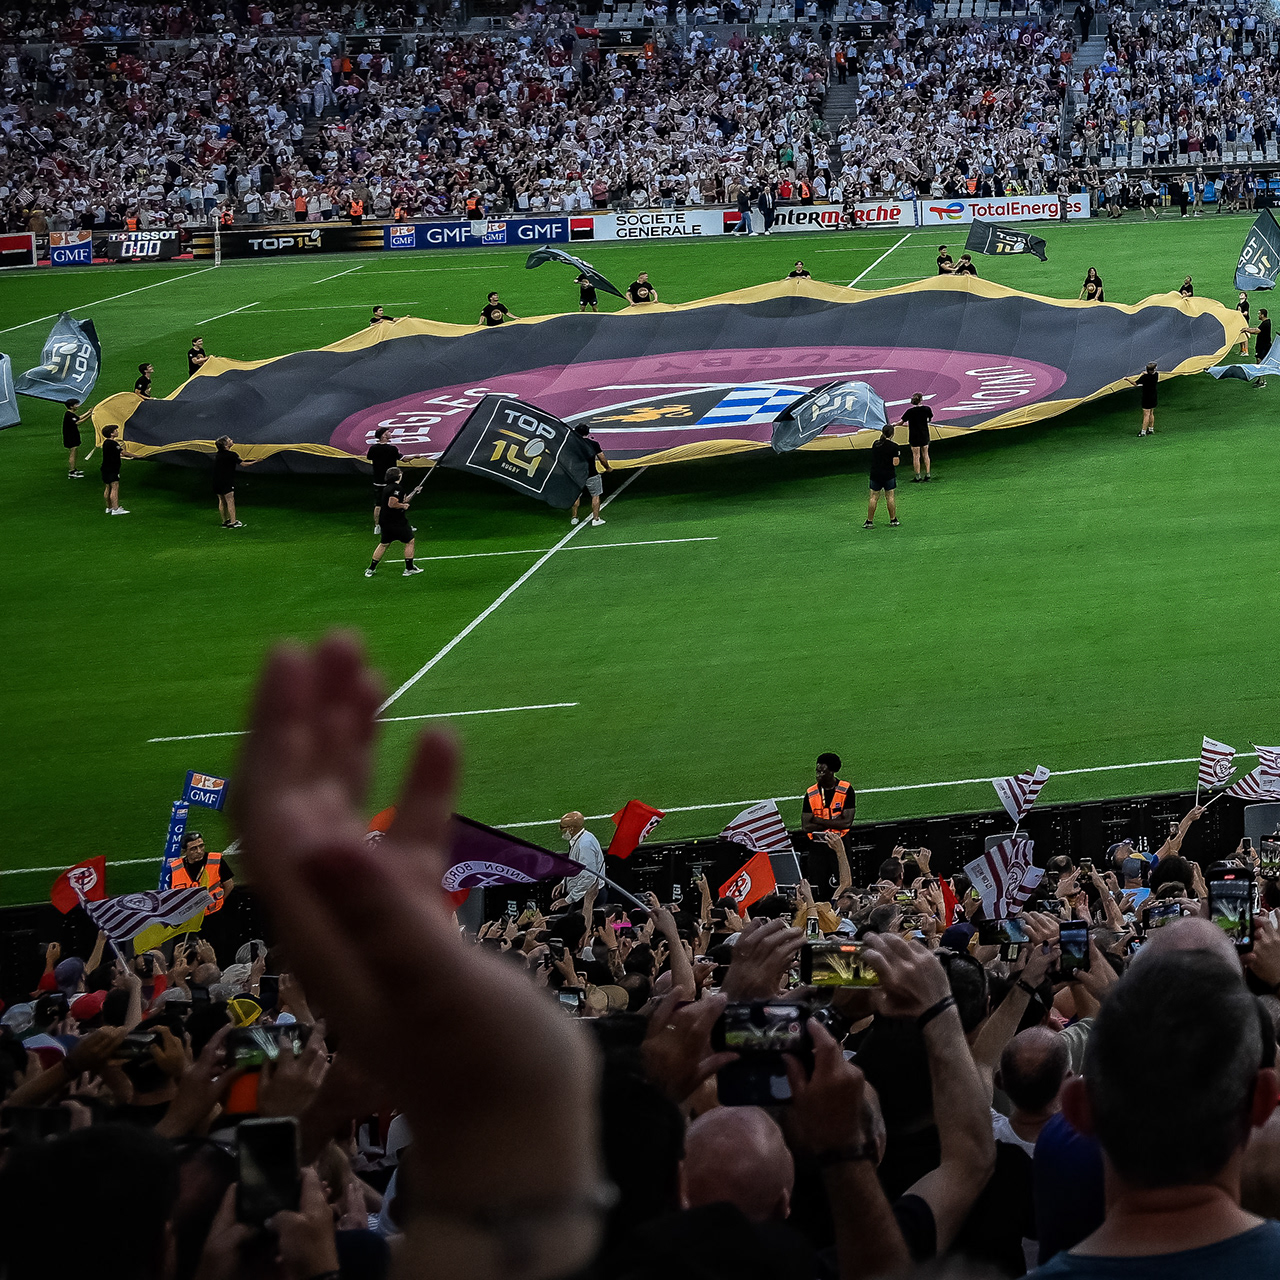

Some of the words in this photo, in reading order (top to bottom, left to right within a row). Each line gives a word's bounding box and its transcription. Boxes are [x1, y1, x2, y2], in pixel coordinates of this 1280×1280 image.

[968, 201, 1081, 218] TotalEnerges
[616, 213, 686, 226] SOCIETE
[128, 230, 178, 241] TISSOT
[427, 228, 471, 243] GMF
[484, 233, 504, 243] GMF
[518, 223, 562, 239] GMF
[616, 225, 702, 238] GENERALE
[121, 240, 161, 256] 0:00
[248, 232, 321, 251] TOP14
[392, 236, 413, 247] GMF
[53, 248, 89, 263] GMF
[941, 365, 1037, 412] UNION
[503, 410, 556, 440] TOP
[490, 438, 543, 478] 14
[501, 462, 521, 474] RUGBY
[190, 789, 218, 804] GMF
[171, 824, 184, 853] GMF
[673, 884, 681, 900] TGI
